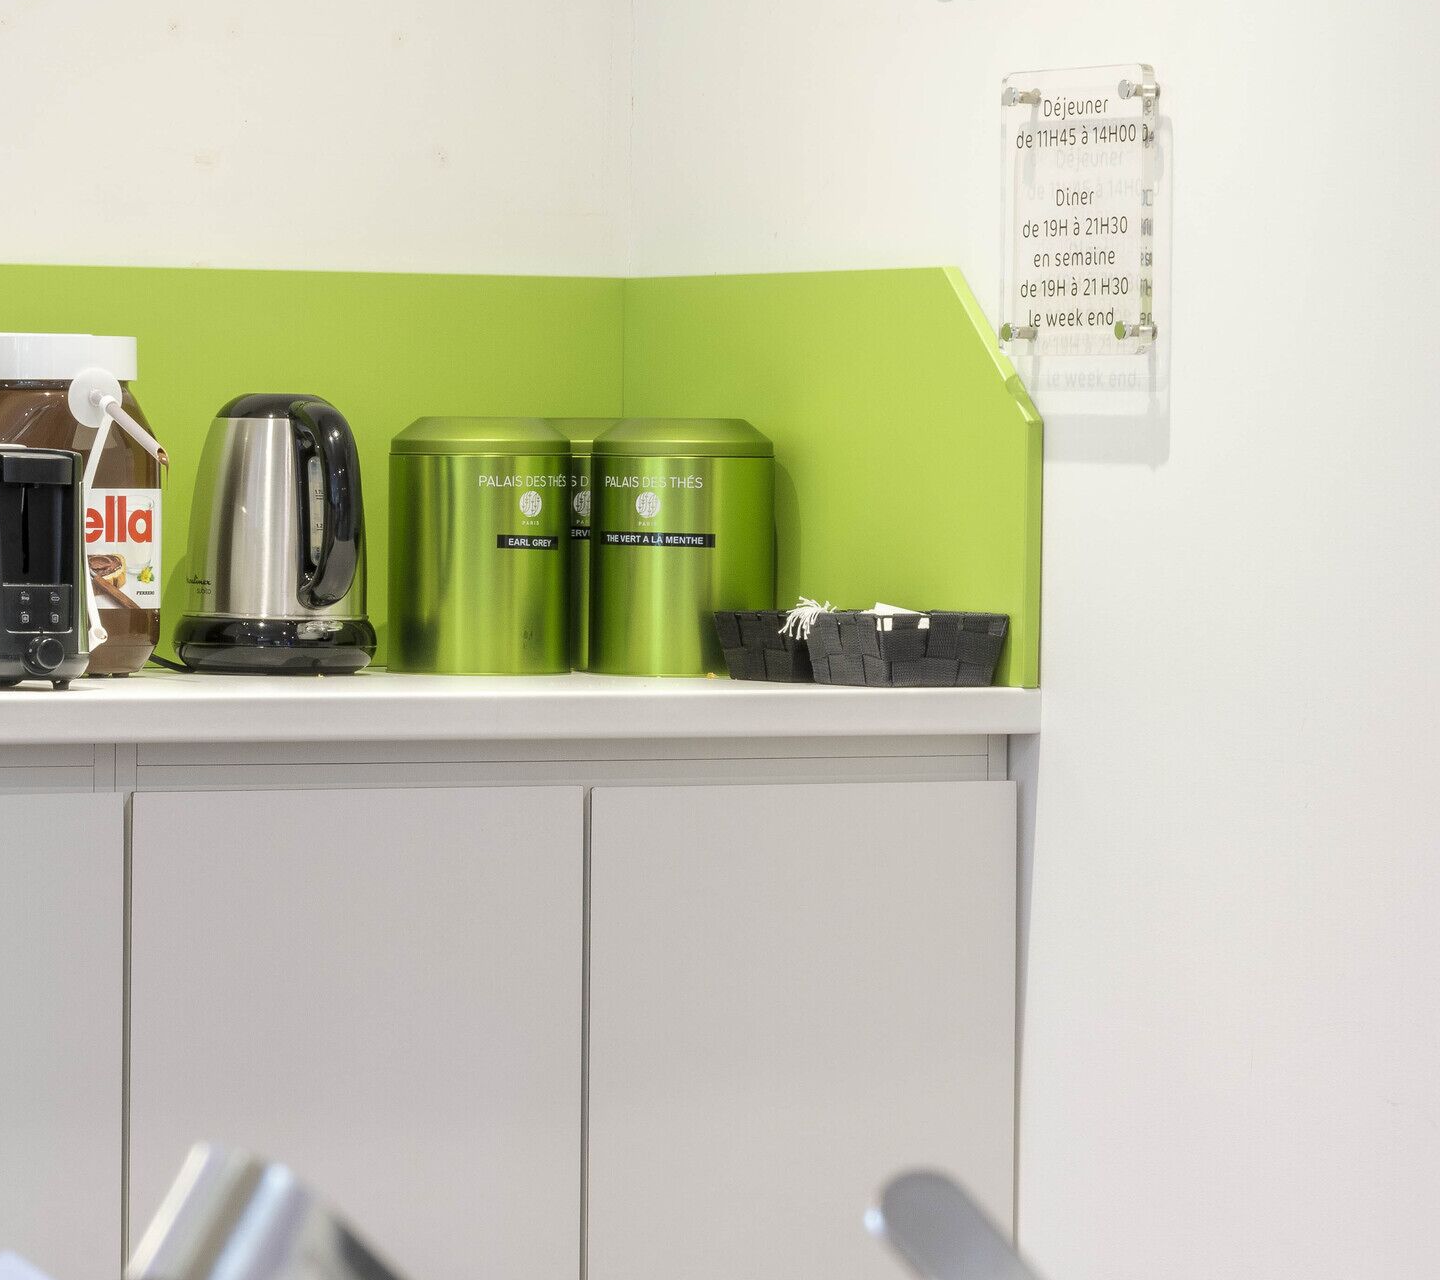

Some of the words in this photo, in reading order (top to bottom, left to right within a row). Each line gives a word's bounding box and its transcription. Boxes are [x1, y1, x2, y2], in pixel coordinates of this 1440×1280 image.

[1044, 96, 1109, 120] Déjeuner
[1016, 130, 1033, 149] de
[1037, 128, 1077, 147] 11H45
[1081, 126, 1089, 145] à
[1093, 124, 1136, 144] 14H00
[1056, 188, 1094, 207] Diner
[1023, 220, 1039, 238] de
[1043, 218, 1068, 237] 19H
[1073, 216, 1080, 236] à
[1085, 216, 1128, 235] 21H30
[1033, 251, 1050, 269] en
[1055, 247, 1116, 268] semaine
[1020, 280, 1037, 298] de
[1041, 279, 1066, 297] 19H
[1071, 277, 1078, 296] à
[1029, 310, 1041, 327] le
[1046, 308, 1083, 327] week
[1088, 307, 1114, 326] end
[479, 476, 522, 487] PALAIS
[526, 476, 547, 487] DES
[548, 474, 566, 487] THÉS
[605, 476, 639, 488] PALAIS
[642, 477, 666, 488] DES
[669, 475, 703, 488] THÉS
[85, 495, 153, 543] ella
[508, 538, 530, 547] EARL
[533, 539, 552, 547] GREY
[607, 534, 619, 542] THE
[620, 535, 641, 543] VERT
[665, 536, 704, 545] MENTHE
